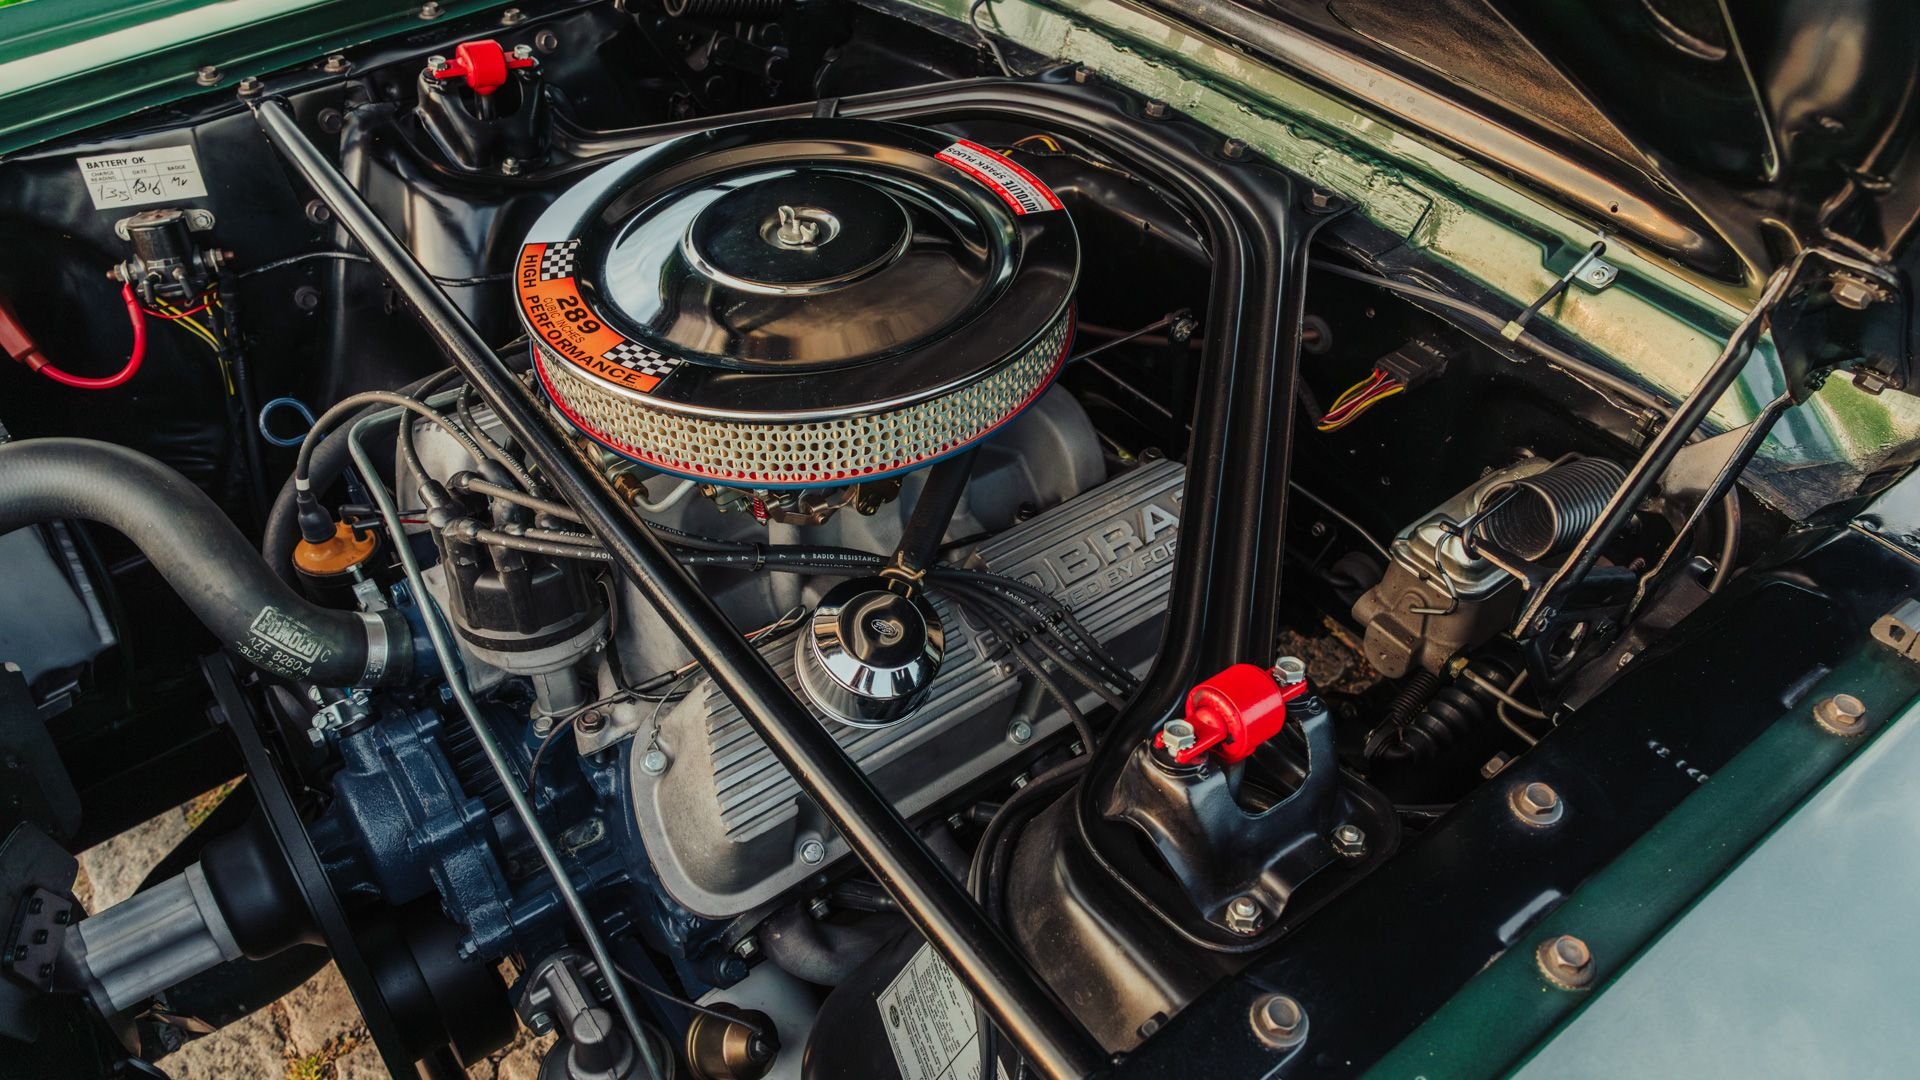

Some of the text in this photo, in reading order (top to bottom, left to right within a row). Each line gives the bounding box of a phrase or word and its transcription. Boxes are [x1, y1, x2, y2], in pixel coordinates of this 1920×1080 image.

[86, 156, 146, 170] BATTERY OK
[946, 147, 976, 162] PLUGS
[975, 161, 1006, 179] SPARK
[1001, 179, 1039, 211] AUTOLITE
[523, 254, 642, 384] HIGH PERFORMANCE
[543, 297, 585, 344] CUBIC INCHES
[557, 295, 601, 334] 289
[560, 530, 586, 538] RADIO
[1004, 503, 1180, 595] OBRA
[839, 554, 880, 563] RESISTANCE
[1105, 540, 1177, 588] BY FOR
